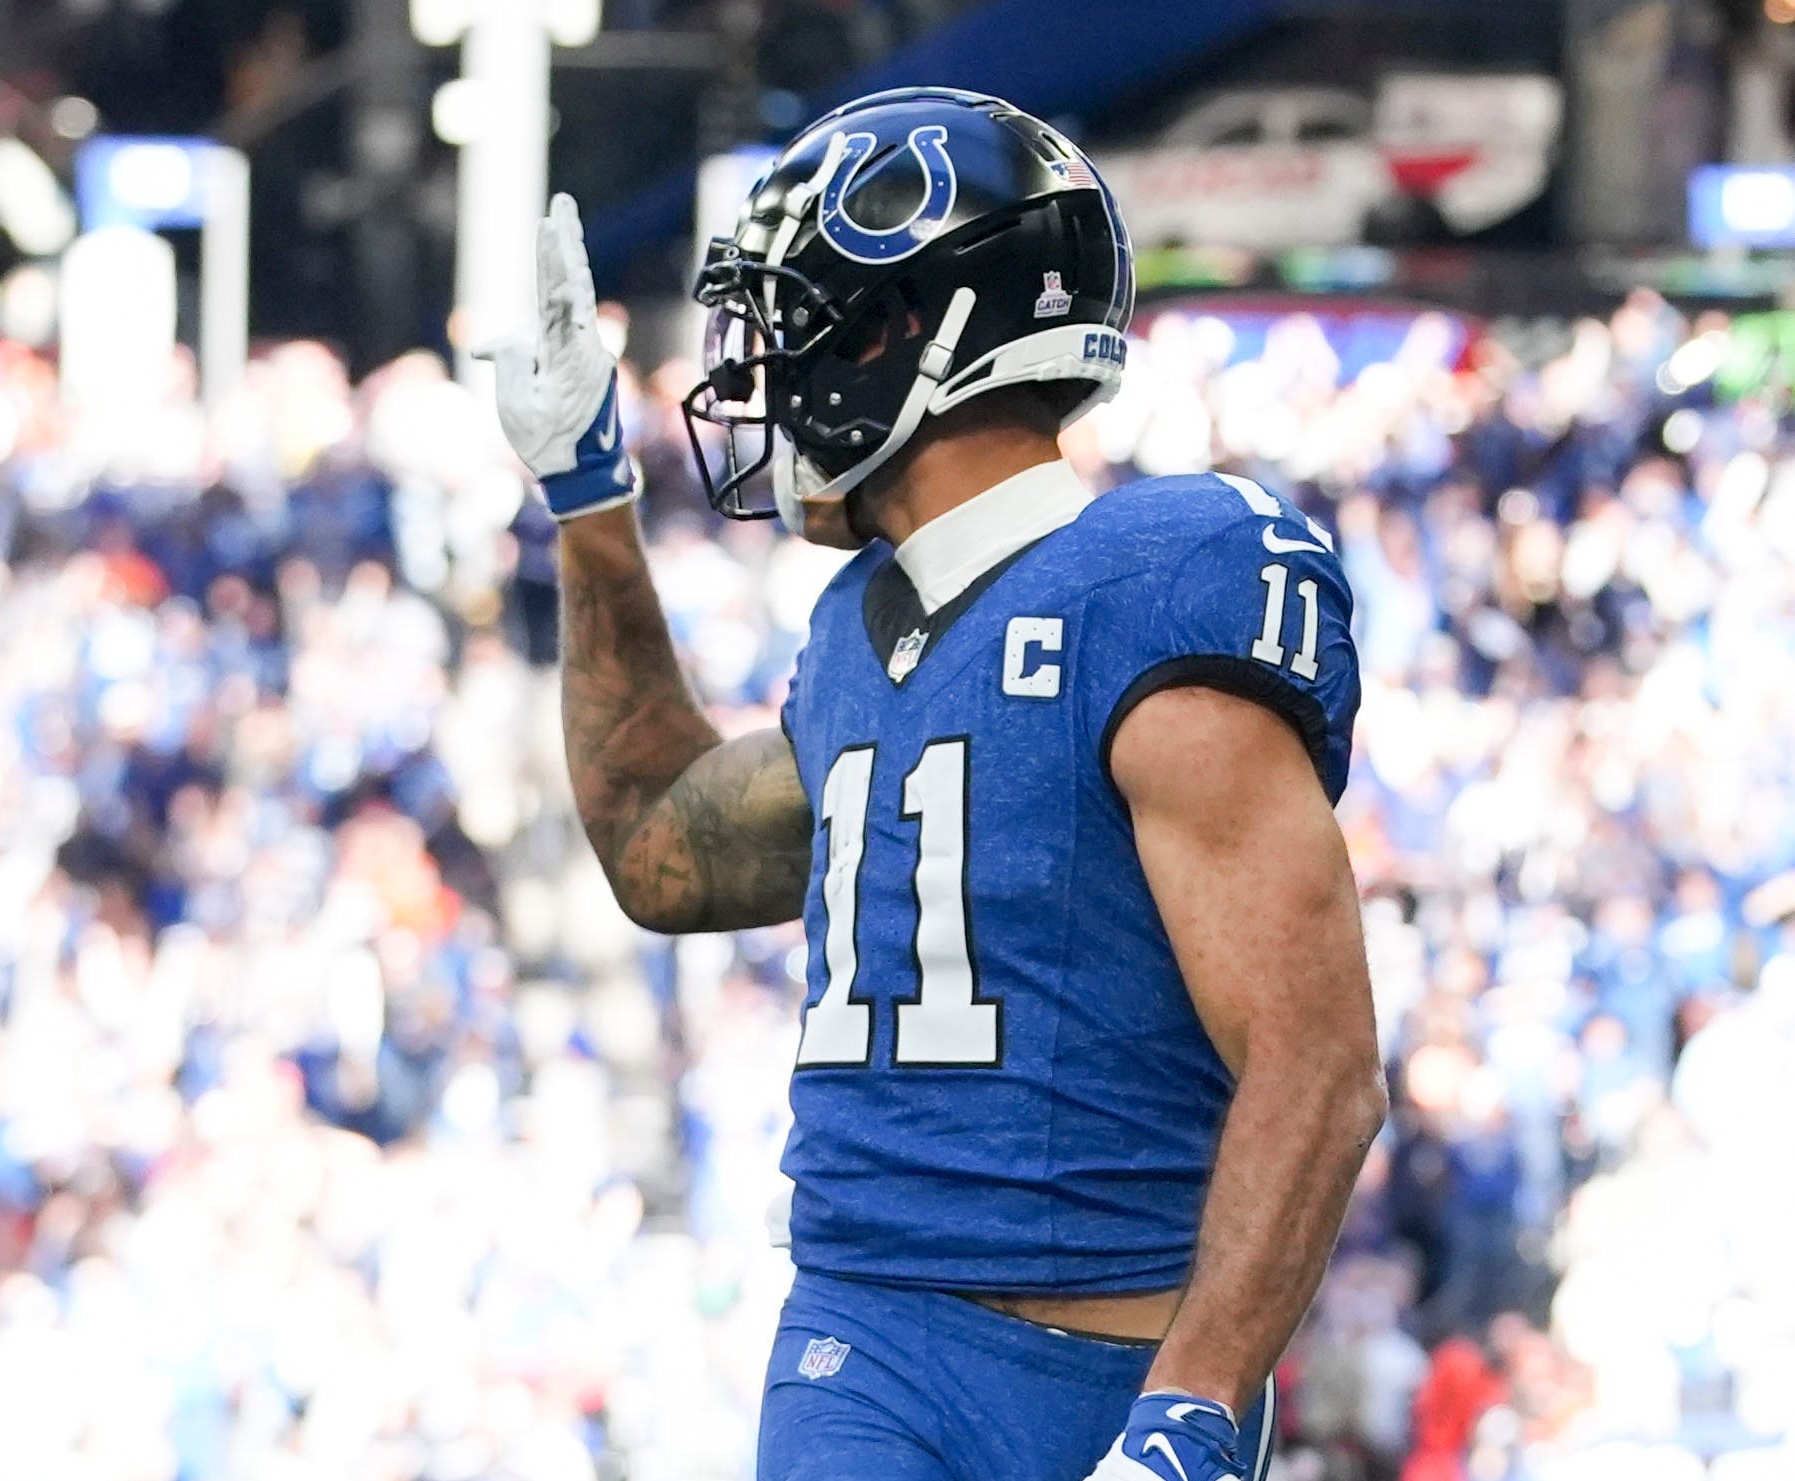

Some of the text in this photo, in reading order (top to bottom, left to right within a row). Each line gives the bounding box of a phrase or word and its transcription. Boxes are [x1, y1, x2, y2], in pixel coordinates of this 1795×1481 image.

[1002, 616, 1063, 698] C
[1251, 562, 1320, 682] 11
[796, 738, 1000, 1066] 11
